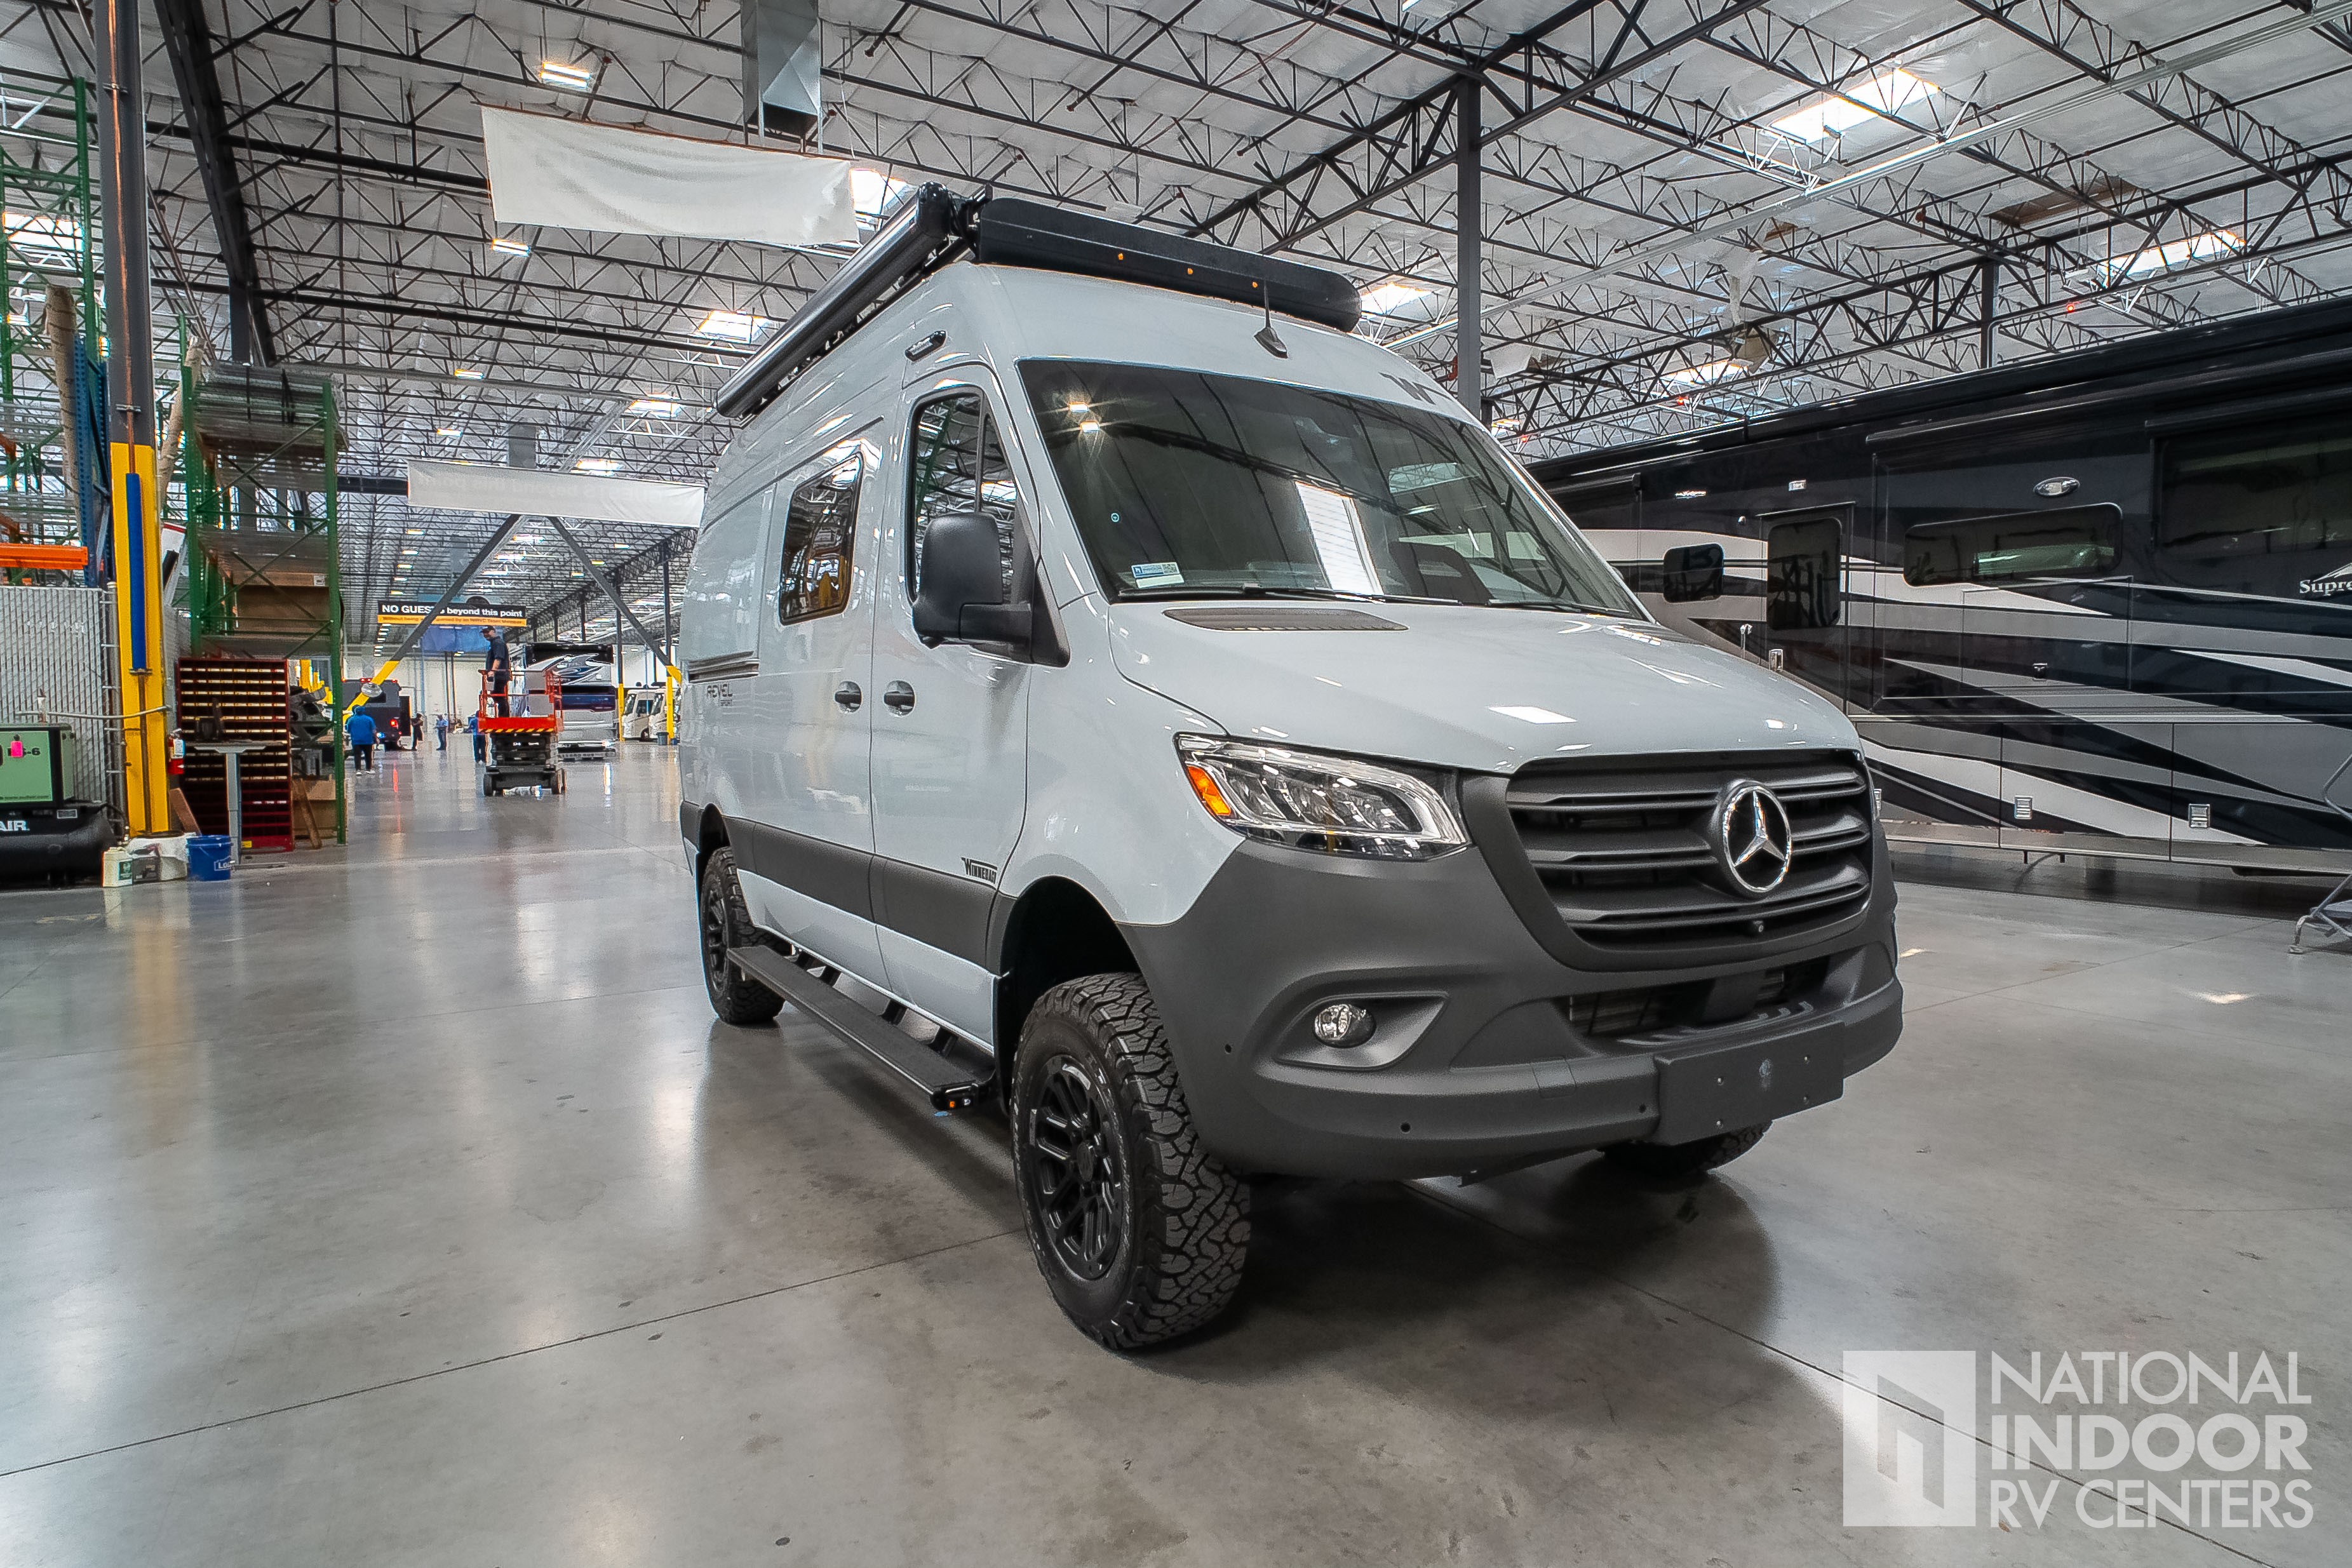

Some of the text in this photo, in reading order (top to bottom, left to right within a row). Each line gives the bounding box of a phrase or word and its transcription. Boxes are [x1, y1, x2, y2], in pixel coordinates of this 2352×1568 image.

[382, 604, 399, 613] NO
[401, 605, 445, 614] GUES
[447, 606, 480, 616] beyond
[500, 609, 523, 617] point
